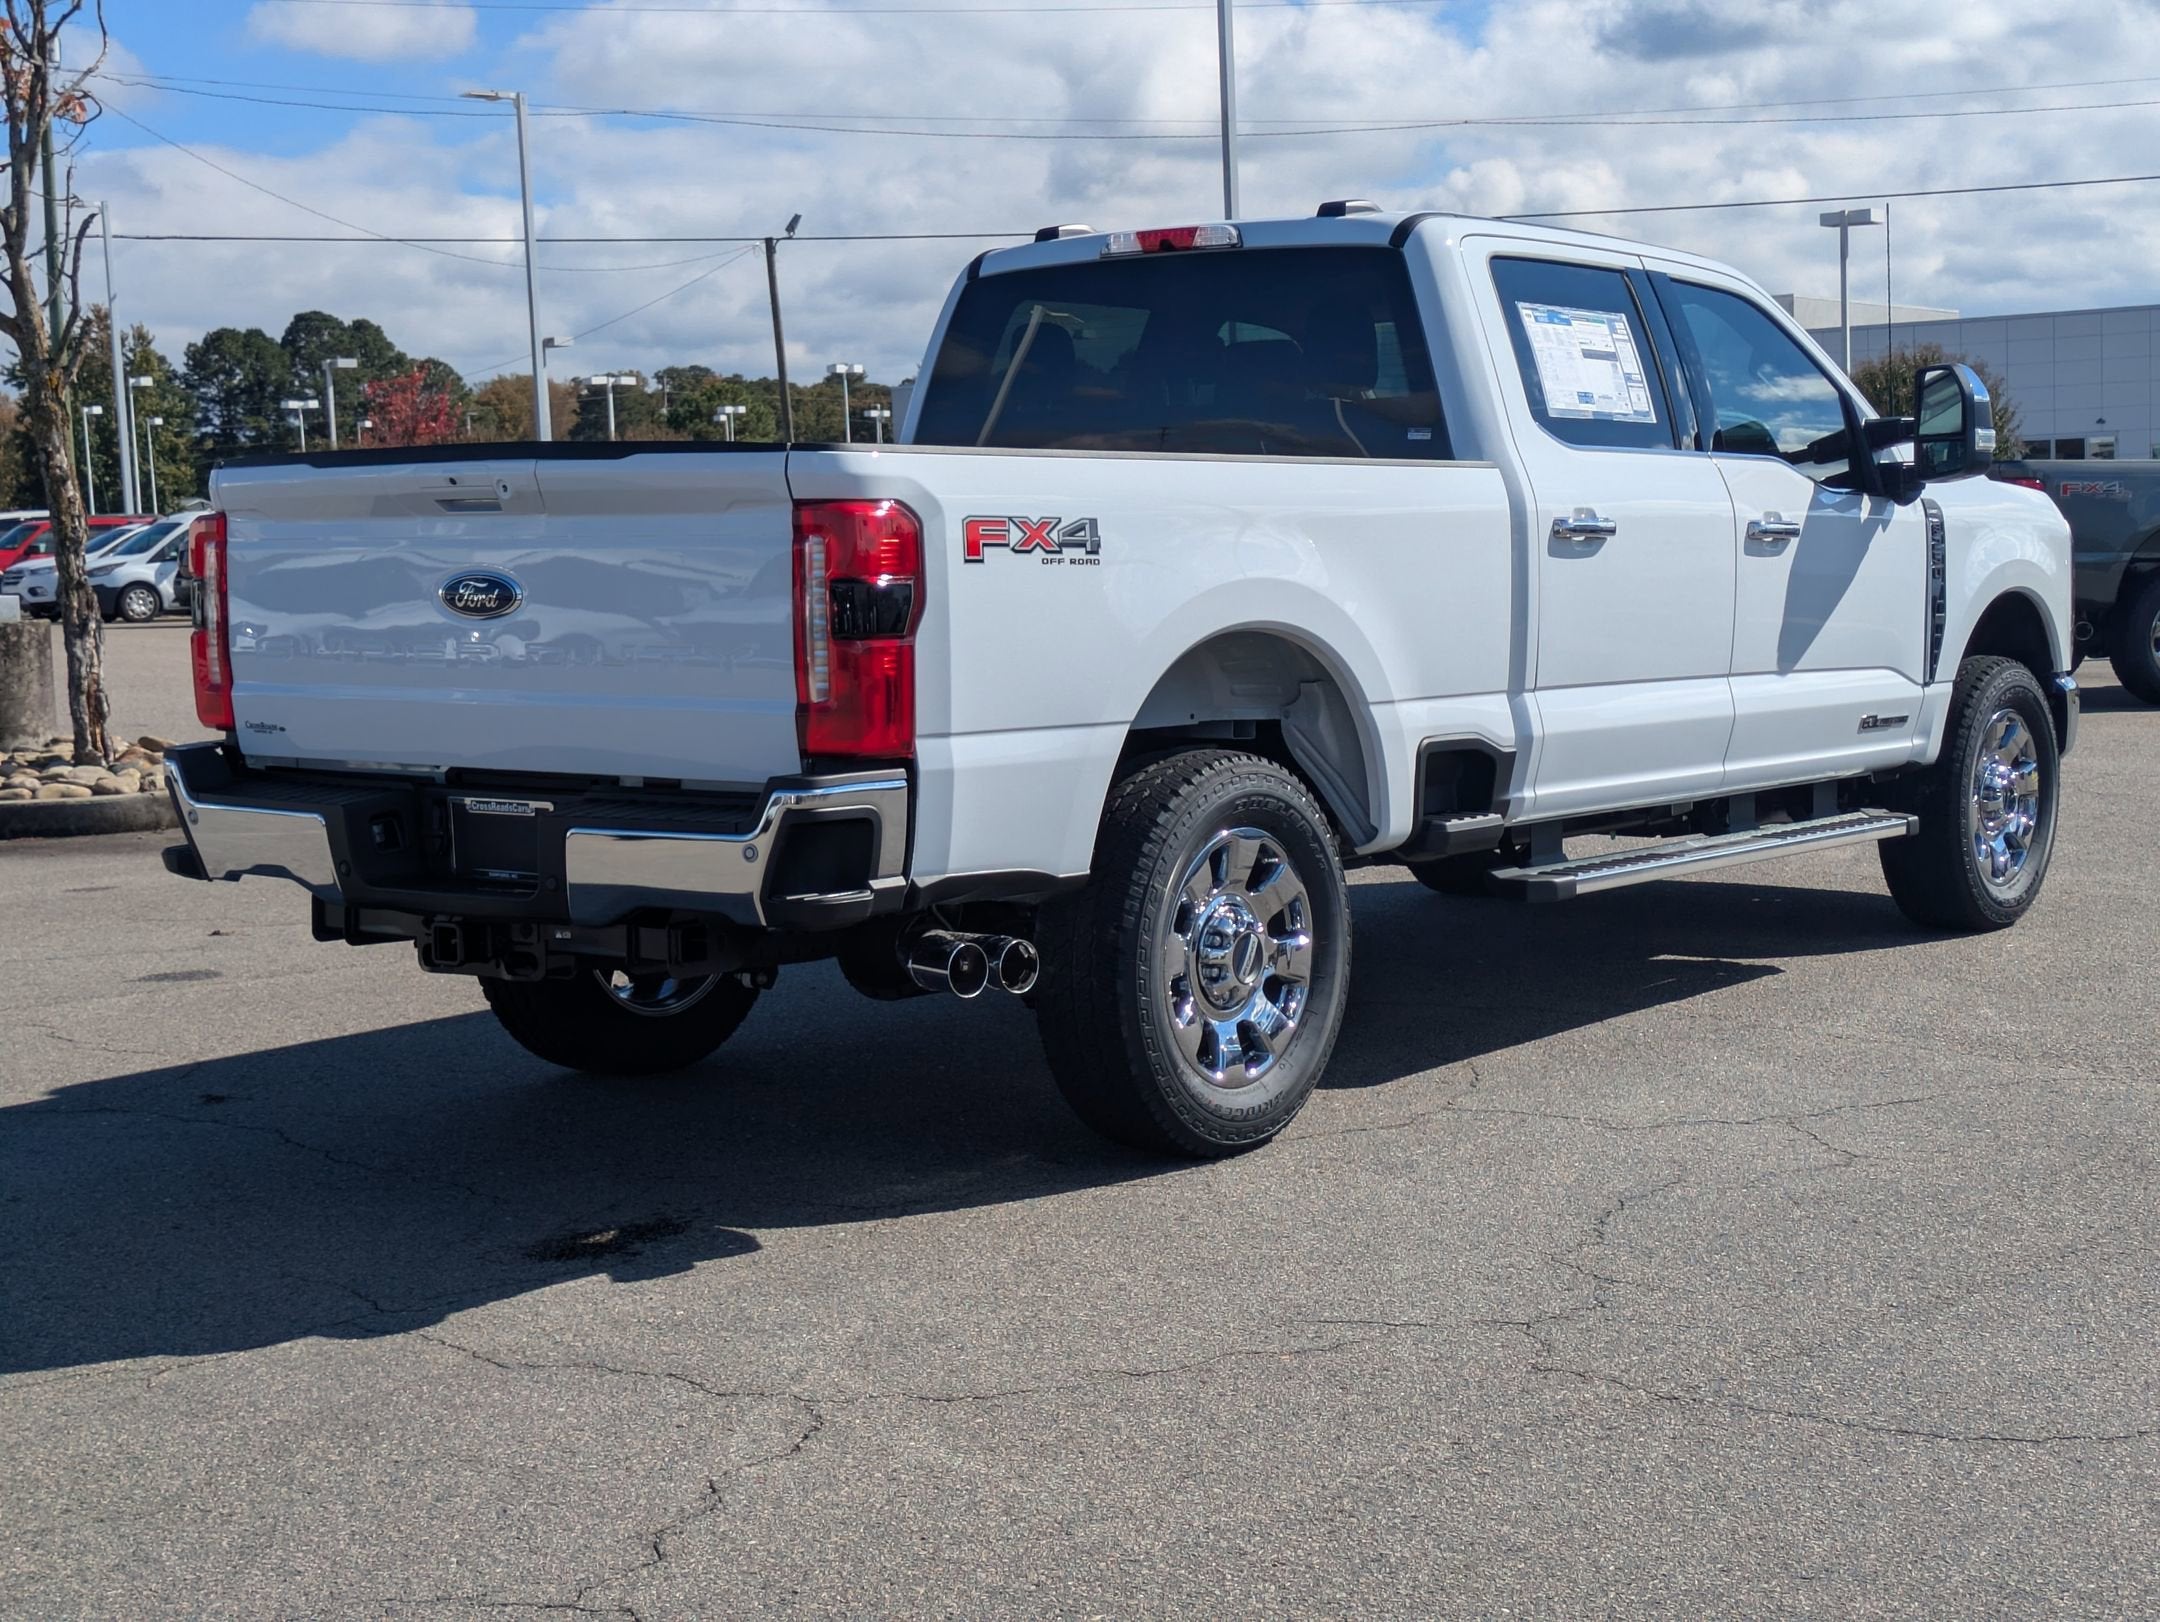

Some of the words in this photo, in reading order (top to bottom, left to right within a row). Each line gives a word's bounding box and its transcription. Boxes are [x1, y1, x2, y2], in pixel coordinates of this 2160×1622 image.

[2060, 480, 2121, 497] FX4
[962, 515, 1101, 563] FX4
[1041, 557, 1065, 566] OFF
[1069, 557, 1100, 566] ROAD
[455, 581, 499, 608] Ford
